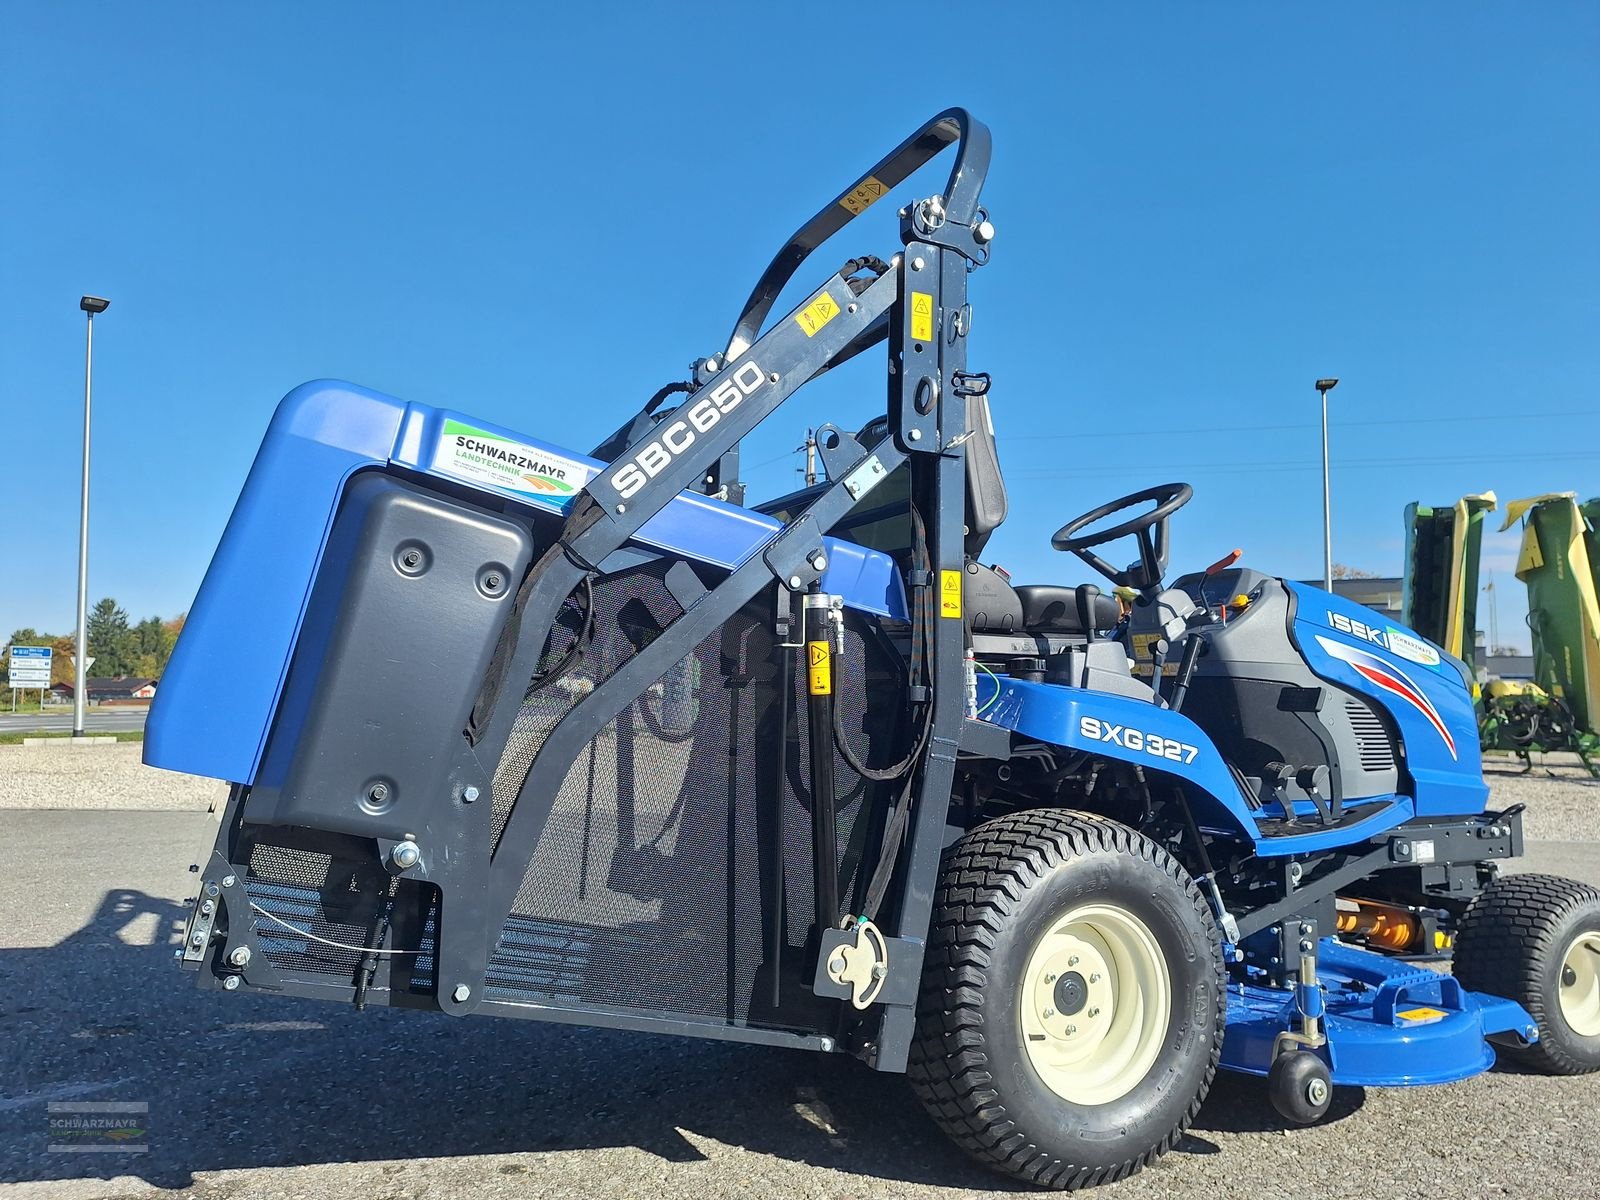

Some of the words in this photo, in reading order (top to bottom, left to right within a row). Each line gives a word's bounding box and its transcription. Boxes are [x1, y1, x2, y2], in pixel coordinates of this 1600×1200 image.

[610, 360, 765, 499] SBC650
[455, 449, 521, 477] LANDTECHNIK
[456, 436, 566, 480] SCHWARZMAYR
[1326, 610, 1390, 649] ISEKI
[1080, 716, 1199, 764] SXG327
